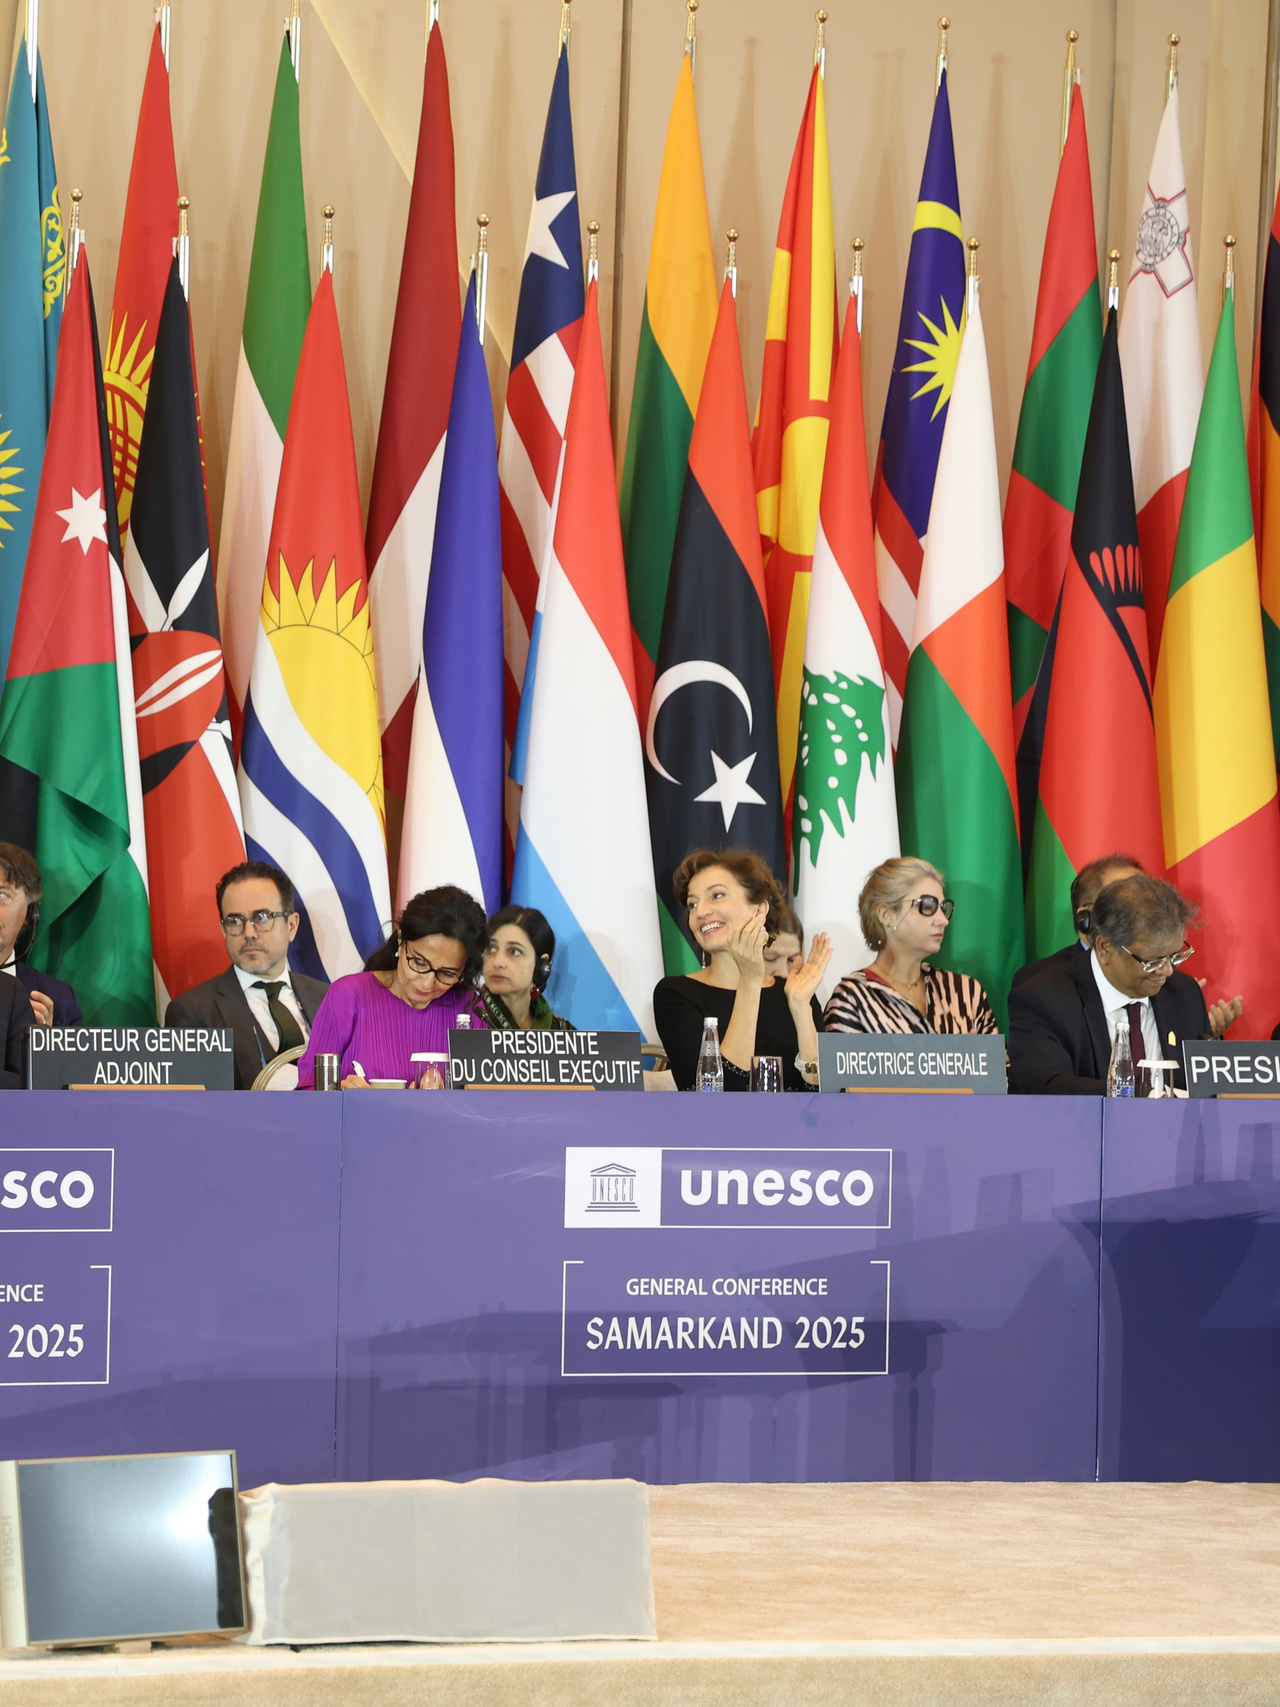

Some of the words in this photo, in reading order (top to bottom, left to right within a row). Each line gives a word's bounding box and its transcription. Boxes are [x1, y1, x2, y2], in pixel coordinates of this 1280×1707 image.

[32, 1027, 141, 1053] DIRECTEUR
[144, 1028, 232, 1053] GENERAL
[490, 1030, 600, 1055] PRESIDENTE
[93, 1061, 173, 1085] ADJOINT
[451, 1058, 477, 1083] DU
[480, 1058, 557, 1083] CONSEIL
[558, 1059, 641, 1084] EXECUTIF
[836, 1051, 915, 1076] DIRECTRICE
[916, 1052, 988, 1076] GENERALE
[591, 1177, 635, 1202] UNESCO
[680, 1169, 874, 1207] unesco
[626, 1278, 708, 1296] GENERAL
[711, 1277, 828, 1296] CONFERENCE
[7, 1323, 84, 1358] 2025
[586, 1316, 783, 1350] SAMARKAND
[794, 1315, 865, 1349] 2025
[1, 1515, 14, 1567] BOSCH
